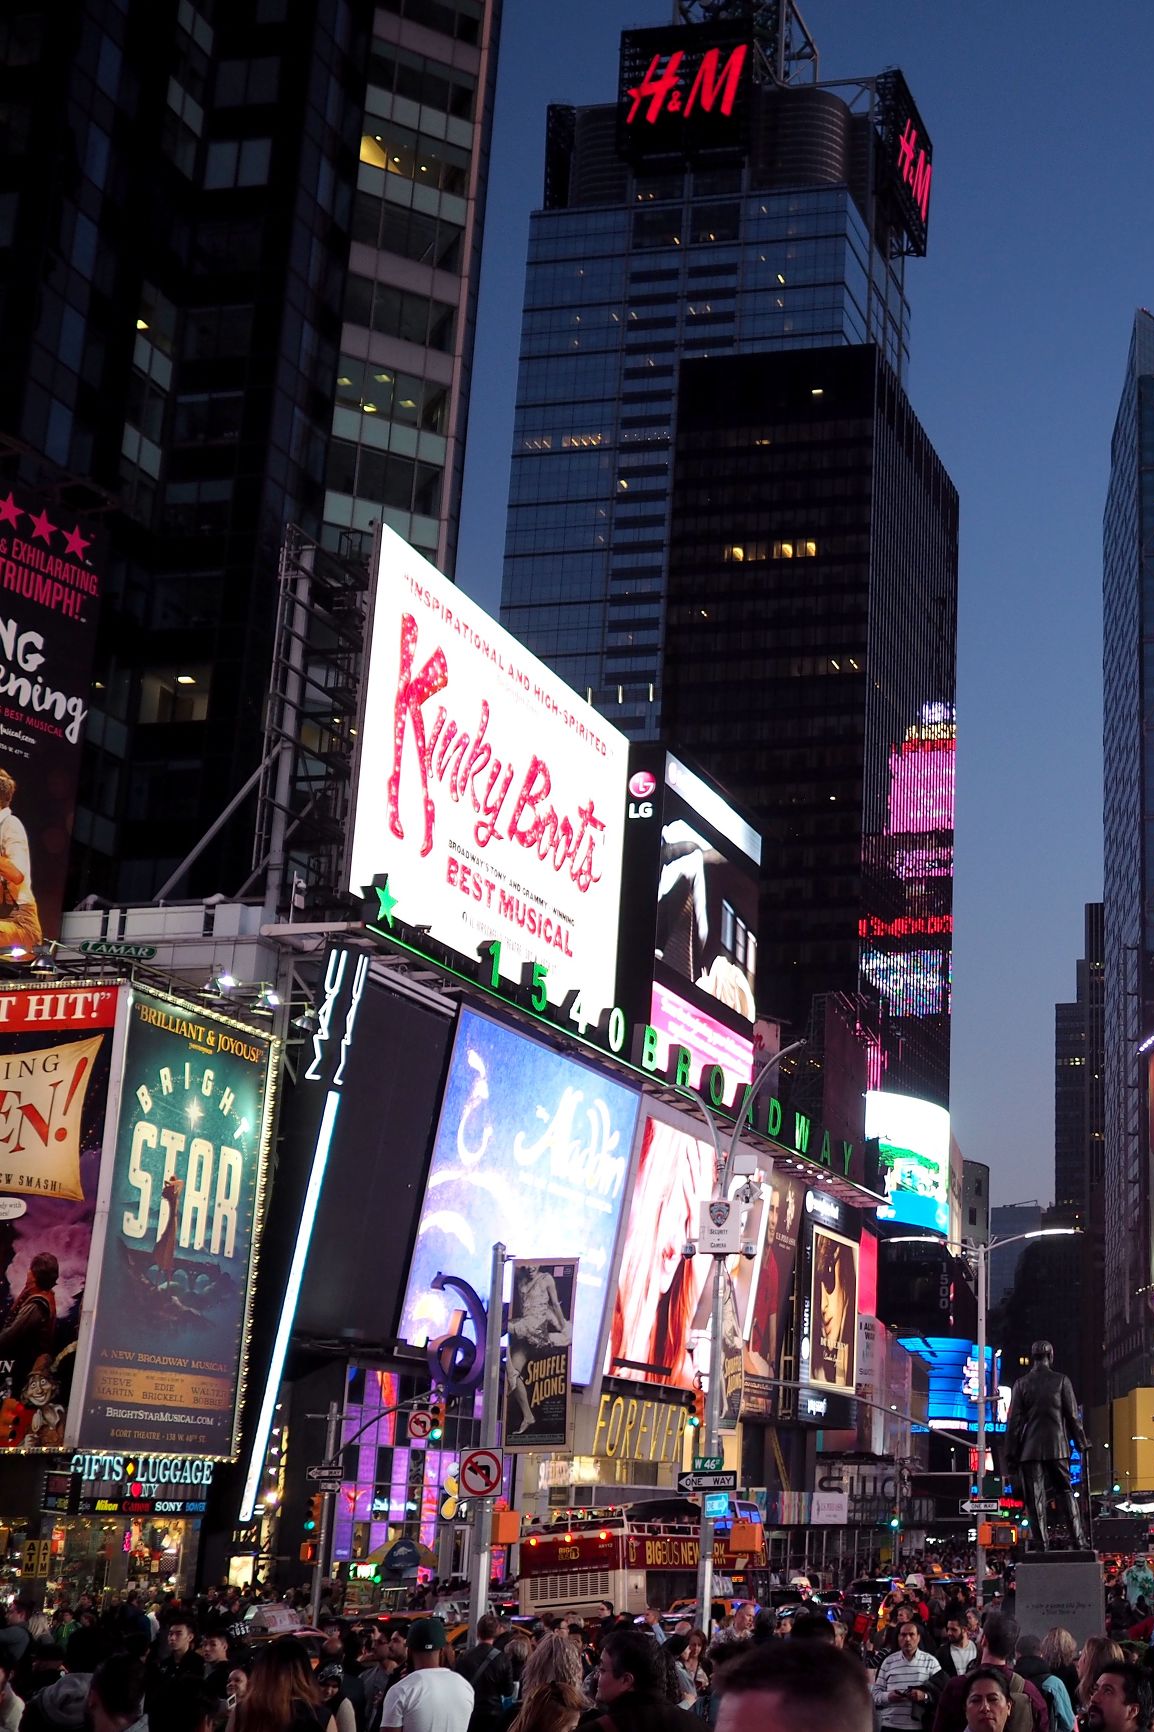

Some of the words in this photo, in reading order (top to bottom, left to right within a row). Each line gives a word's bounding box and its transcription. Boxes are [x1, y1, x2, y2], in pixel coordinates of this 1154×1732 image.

[627, 44, 748, 124] H&M
[897, 118, 932, 223] H&M
[508, 664, 530, 691] AND
[387, 612, 515, 857] Kinky
[509, 755, 607, 893] Boots
[628, 802, 653, 819] LG
[446, 855, 496, 909] BEST
[498, 888, 574, 958] MUSICAL
[86, 941, 150, 957] LAMAR
[206, 1030, 215, 1047] &
[136, 1062, 250, 1140] BRIGHT
[641, 1025, 853, 1176] BROADWAY
[18, 1175, 63, 1193] SMASH!
[122, 1120, 243, 1258] STAR
[939, 1262, 949, 1310] 1500
[110, 1350, 136, 1361] NEW
[137, 1354, 190, 1368] BROADWAY
[191, 1360, 228, 1372] MUSICAL
[525, 1354, 566, 1386] SHUFFLE
[98, 1387, 134, 1398] MARTIN
[141, 1392, 184, 1404] BRICKELL
[101, 1377, 132, 1388] STEVE
[154, 1382, 176, 1393] EDIE
[530, 1375, 567, 1409] ALONG
[592, 1394, 688, 1463] FOREVER
[70, 1454, 124, 1481] GIFTS
[136, 1457, 214, 1485] LUGGAGE
[694, 1458, 702, 1470] W
[141, 1483, 160, 1498] NY
[685, 1478, 703, 1487] ONE
[713, 1476, 732, 1486] WAY
[95, 1500, 119, 1511] Nikon
[122, 1500, 151, 1512] Canon
[154, 1501, 184, 1512] SONY
[24, 1541, 36, 1573] ATM
[40, 1540, 48, 1573] ATM
[681, 1541, 701, 1565] NEW
